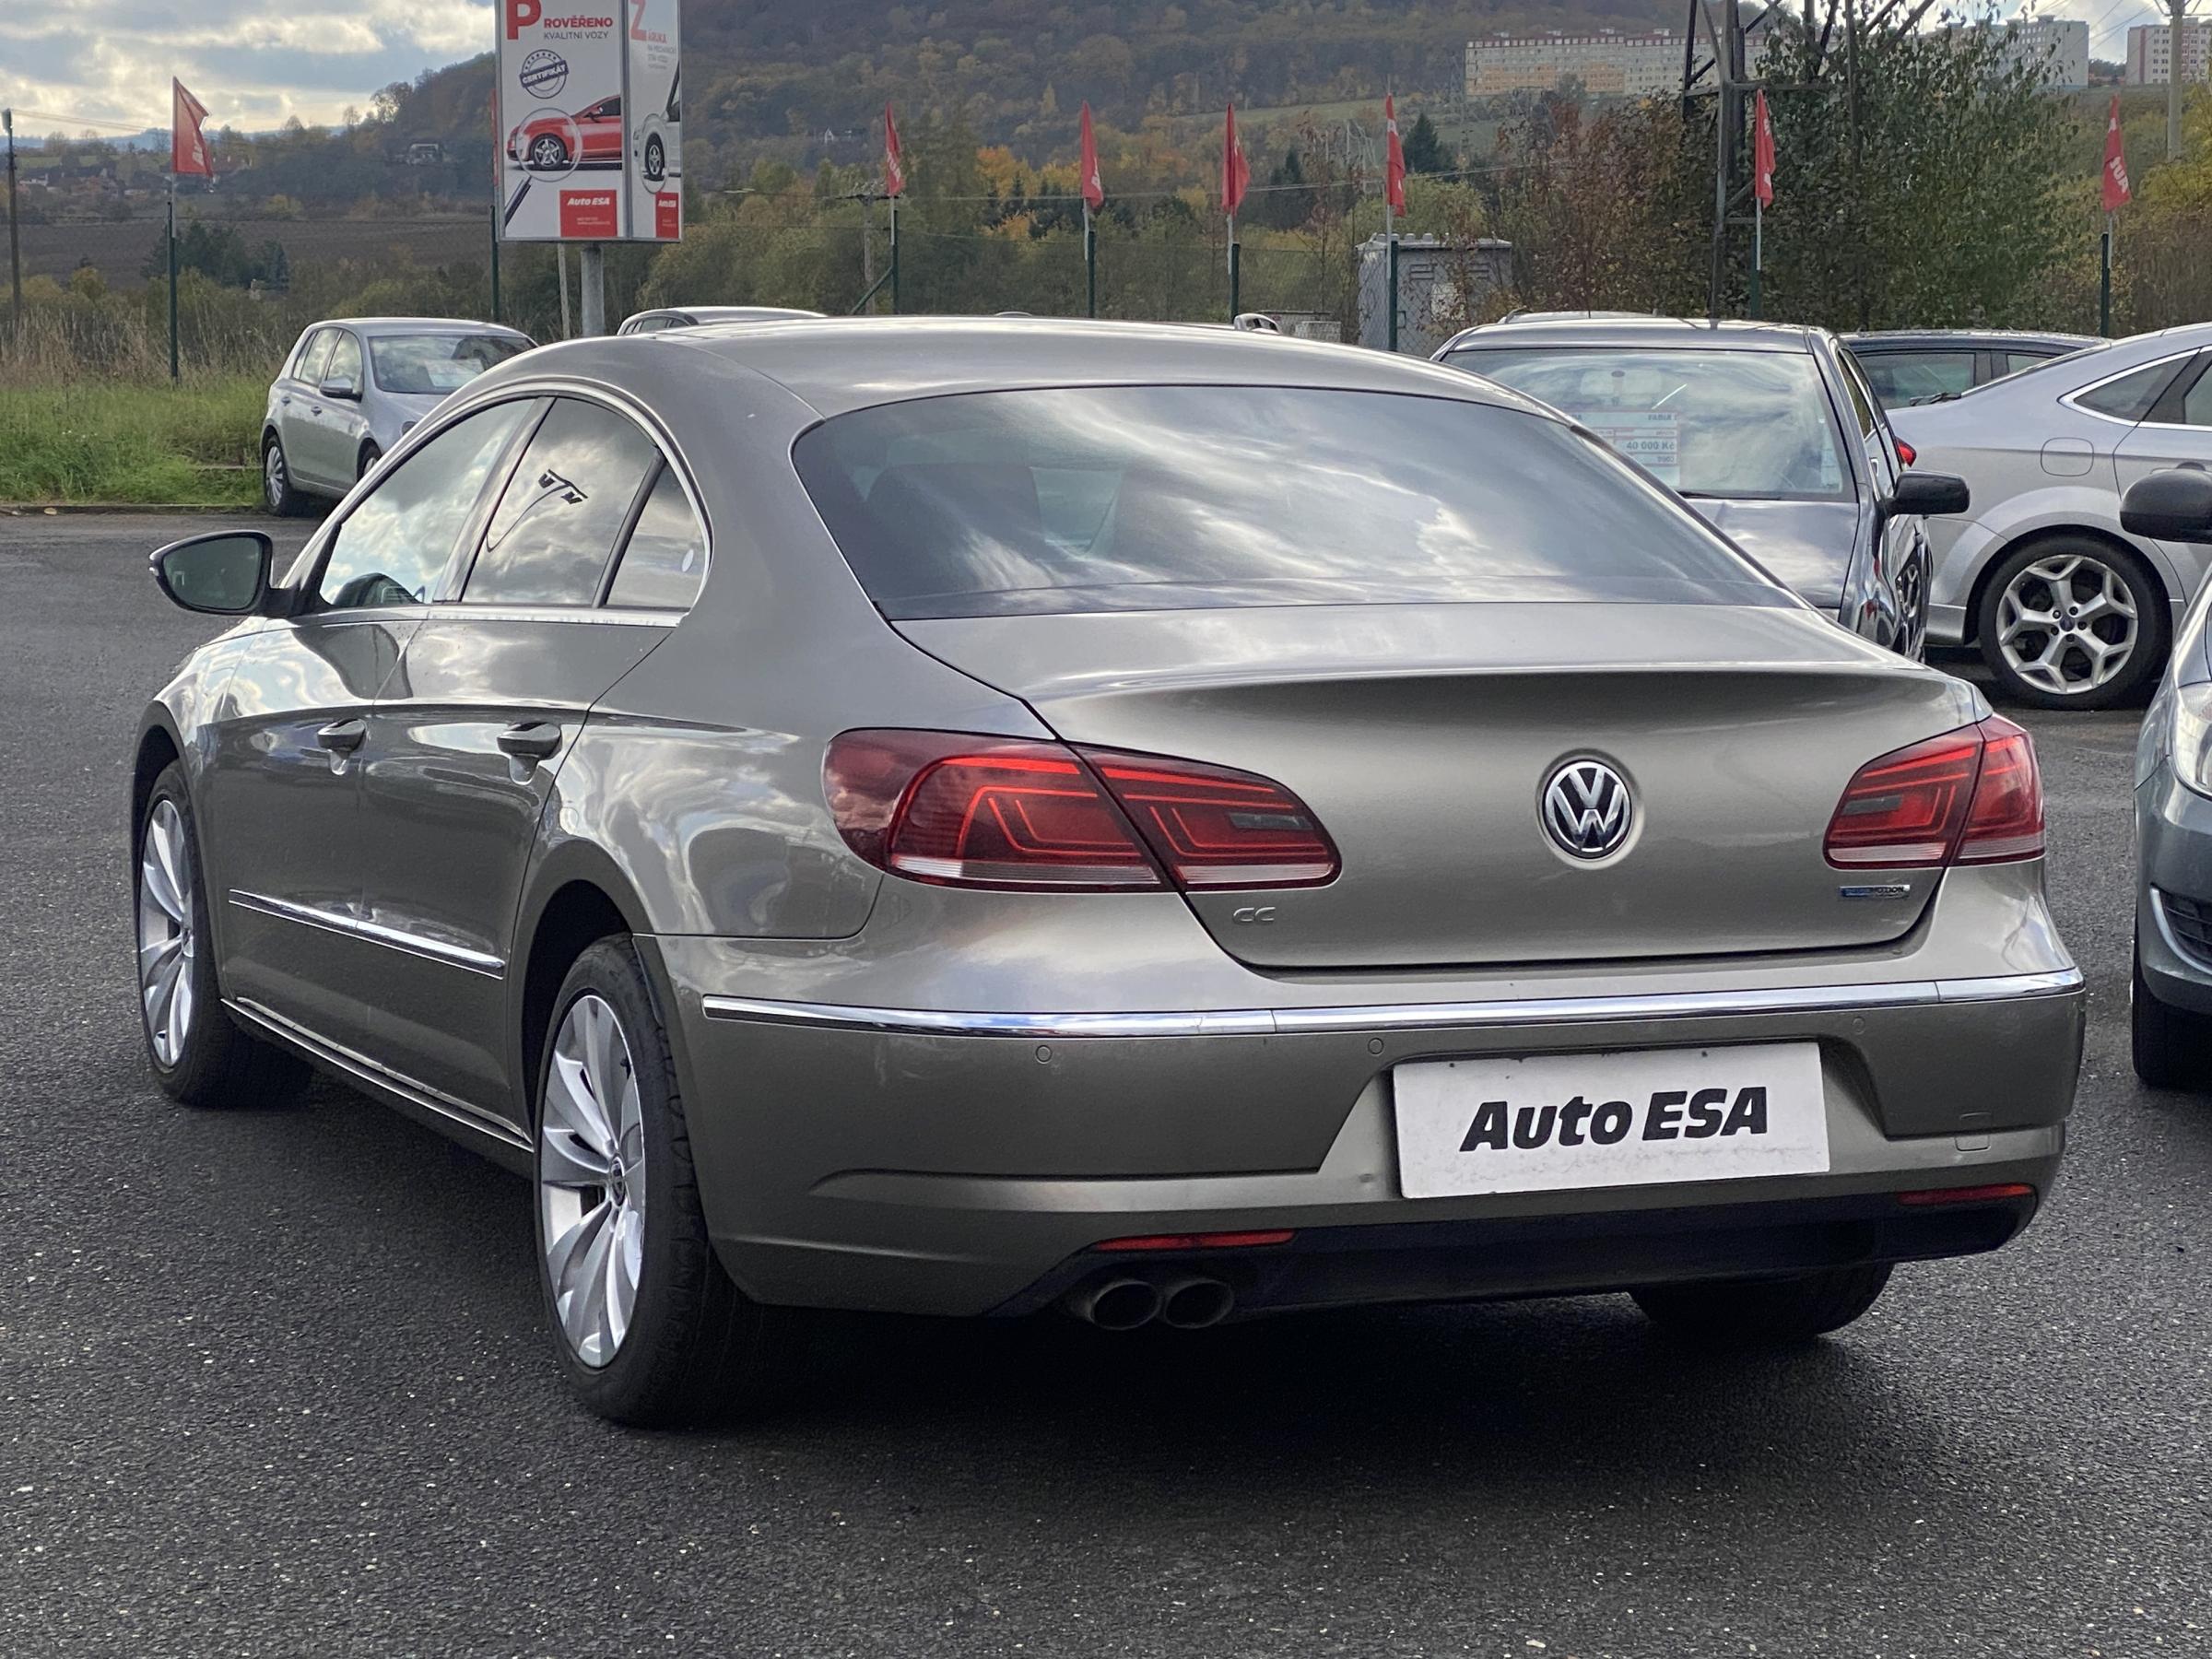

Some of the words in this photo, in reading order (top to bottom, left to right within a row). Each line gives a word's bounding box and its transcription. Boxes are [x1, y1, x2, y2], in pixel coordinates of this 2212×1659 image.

[544, 30, 582, 40] KVALITNÍ
[585, 30, 609, 40] VOZY
[567, 197, 591, 206] Auto
[592, 196, 610, 206] ESA
[1232, 907, 1276, 924] CC
[1458, 1096, 1633, 1152] Auto
[1641, 1086, 1768, 1141] ESA
